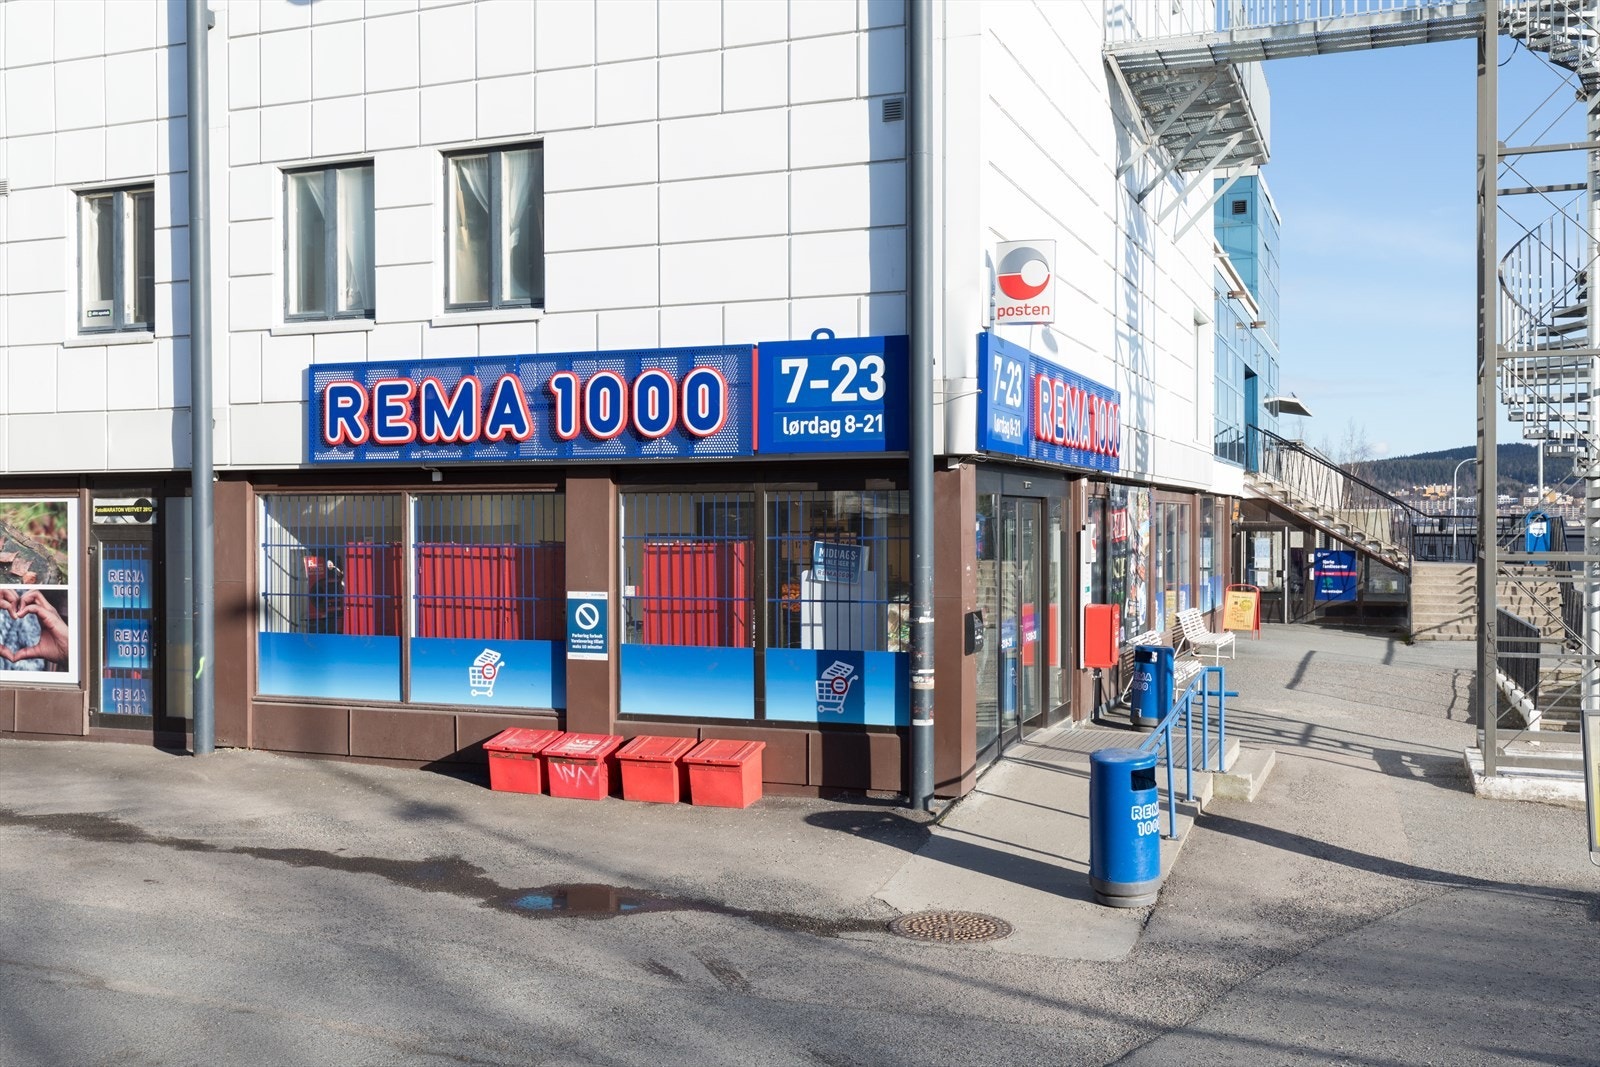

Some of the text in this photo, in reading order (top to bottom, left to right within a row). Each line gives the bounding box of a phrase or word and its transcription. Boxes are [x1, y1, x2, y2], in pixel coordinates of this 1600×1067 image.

[996, 303, 1050, 320] posten
[781, 354, 887, 404] 7-23
[994, 354, 1022, 408] 7-23
[324, 364, 729, 445] REMA 1000
[1034, 374, 1121, 458] REMA 1000
[783, 413, 883, 438] lørdag 8-21
[108, 568, 144, 583] REMA
[113, 584, 141, 598] 1000
[114, 629, 149, 642] REMA
[118, 644, 146, 657] 1000
[112, 687, 146, 702] REMA
[1131, 801, 1159, 820] REM
